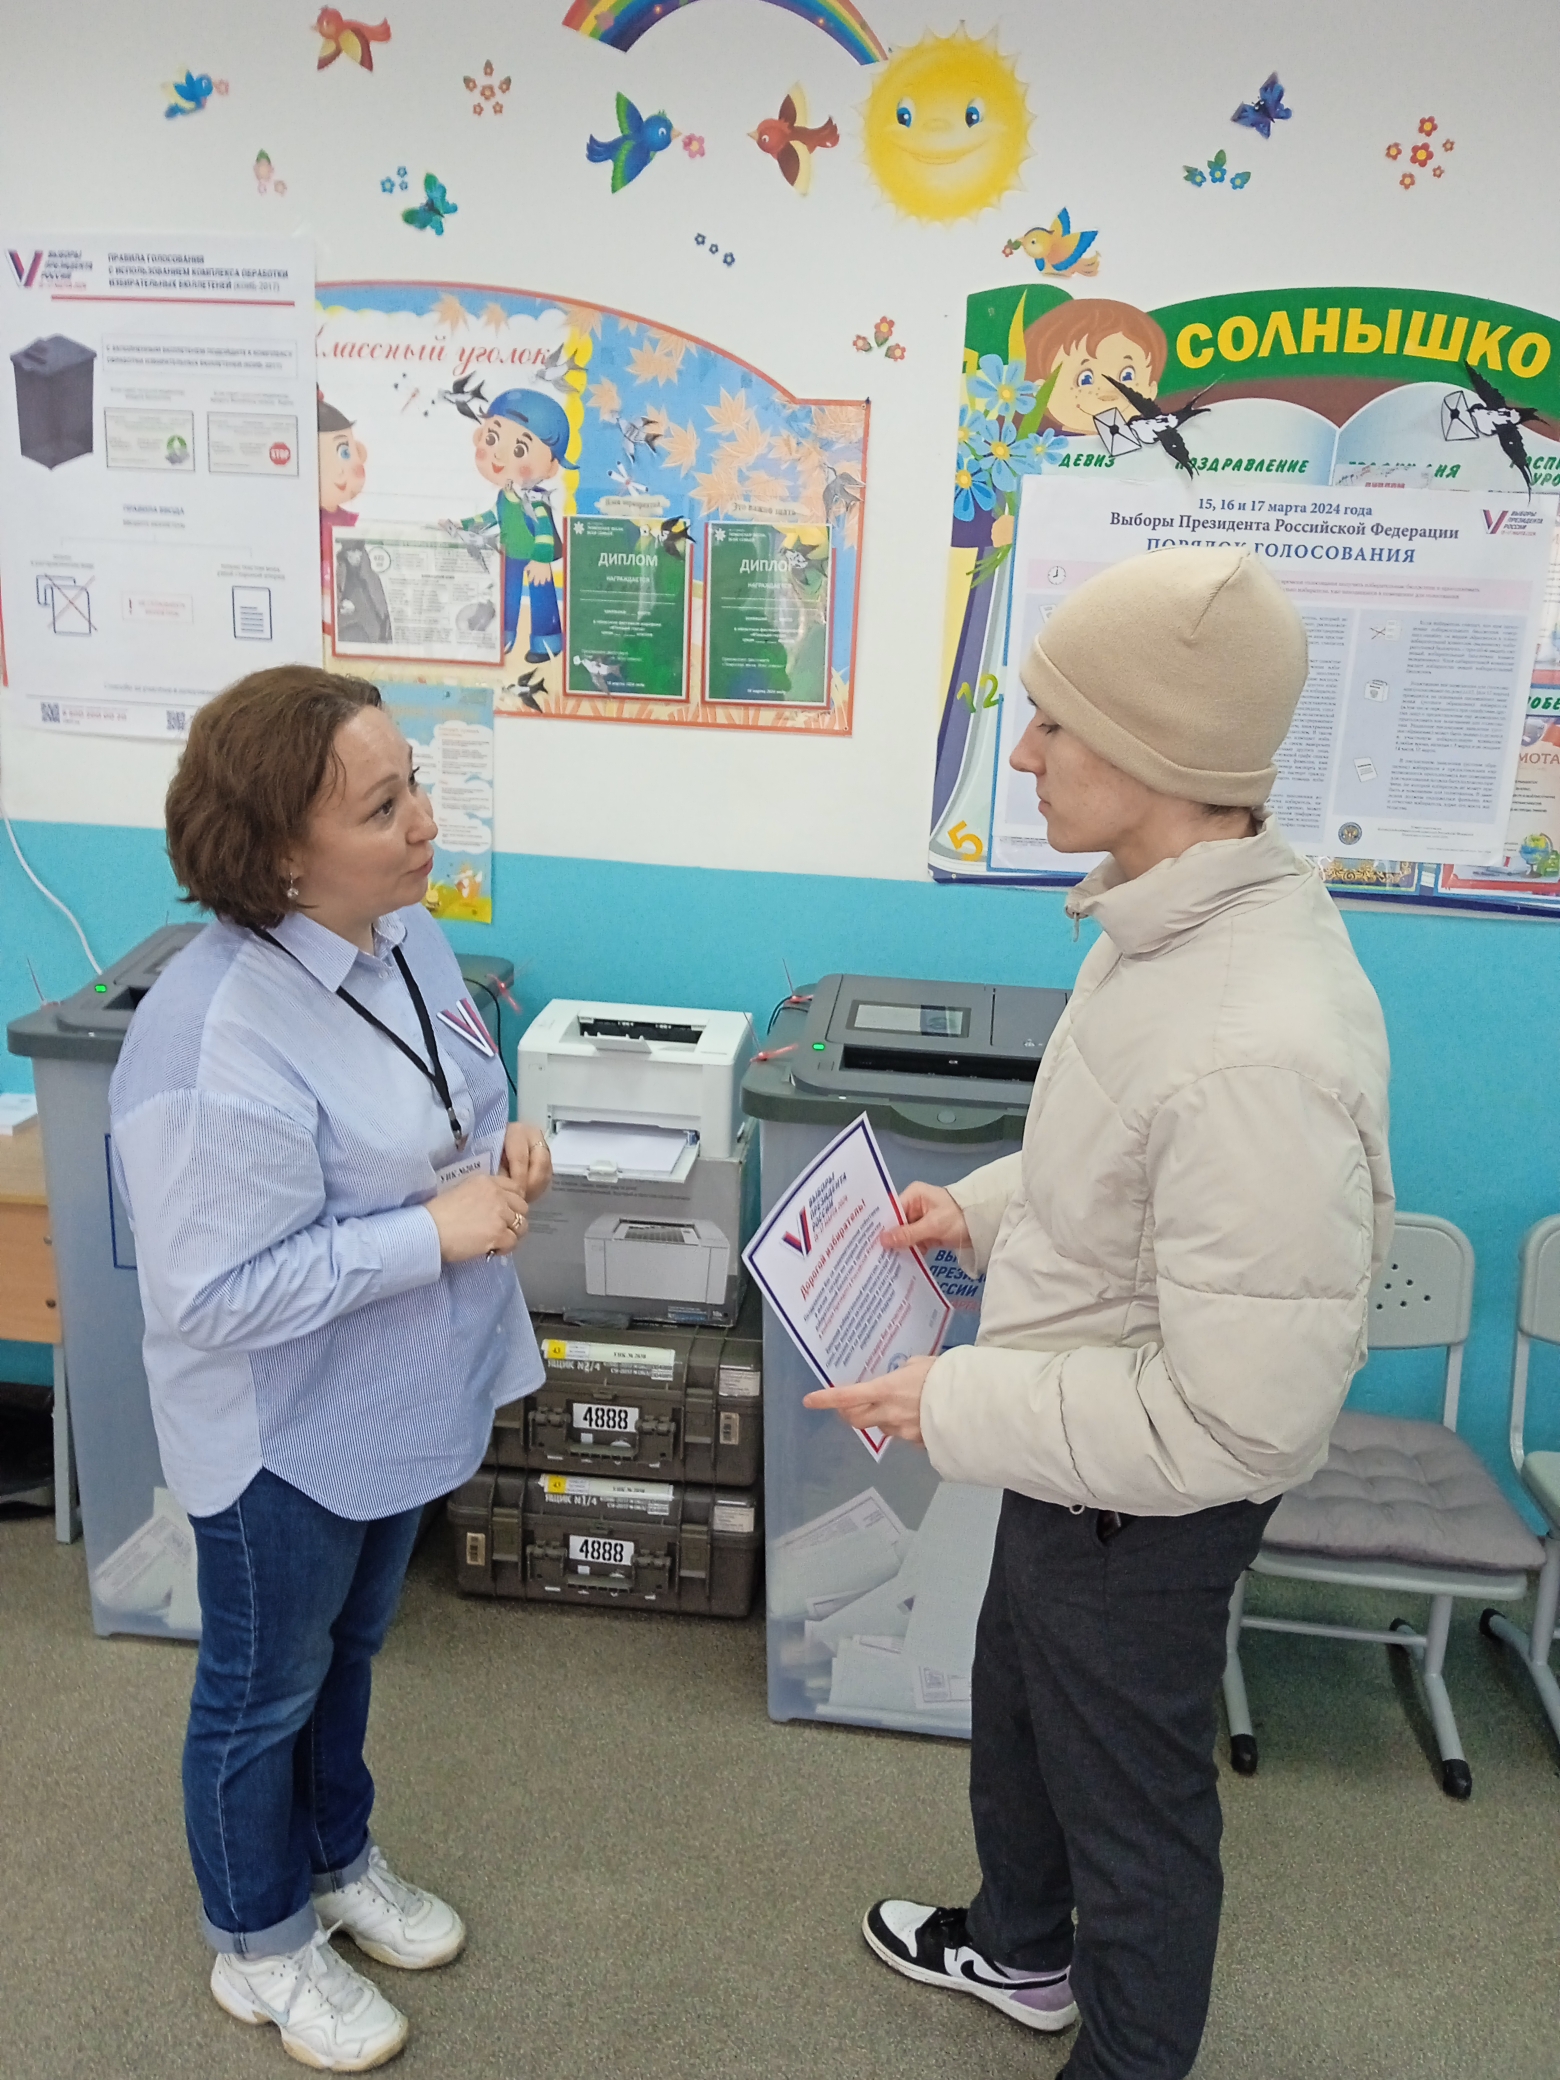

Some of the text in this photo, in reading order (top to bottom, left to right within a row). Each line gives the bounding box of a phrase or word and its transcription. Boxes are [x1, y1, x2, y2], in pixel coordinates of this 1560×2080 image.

[1176, 307, 1551, 378] СОЛНЫШКО
[1059, 453, 1116, 468] ДЕВИЗ
[1199, 498, 1373, 517] 15, 16 и 17 марта 2024 года
[1110, 512, 1459, 541] Выборы Президента Российской Федерации
[598, 552, 658, 567] ДИПЛОМ
[1254, 541, 1416, 563] ГОЛОСОВАНИЯ
[739, 559, 792, 574] ДИПЛО
[947, 820, 983, 861] 5
[810, 1172, 847, 1220] ПРЕЗИДЕНТА
[800, 1198, 867, 1300] Дорогой избиратель!
[937, 1281, 978, 1297] ССИИ
[583, 1406, 628, 1430] 4888
[579, 1539, 624, 1563] 4888
